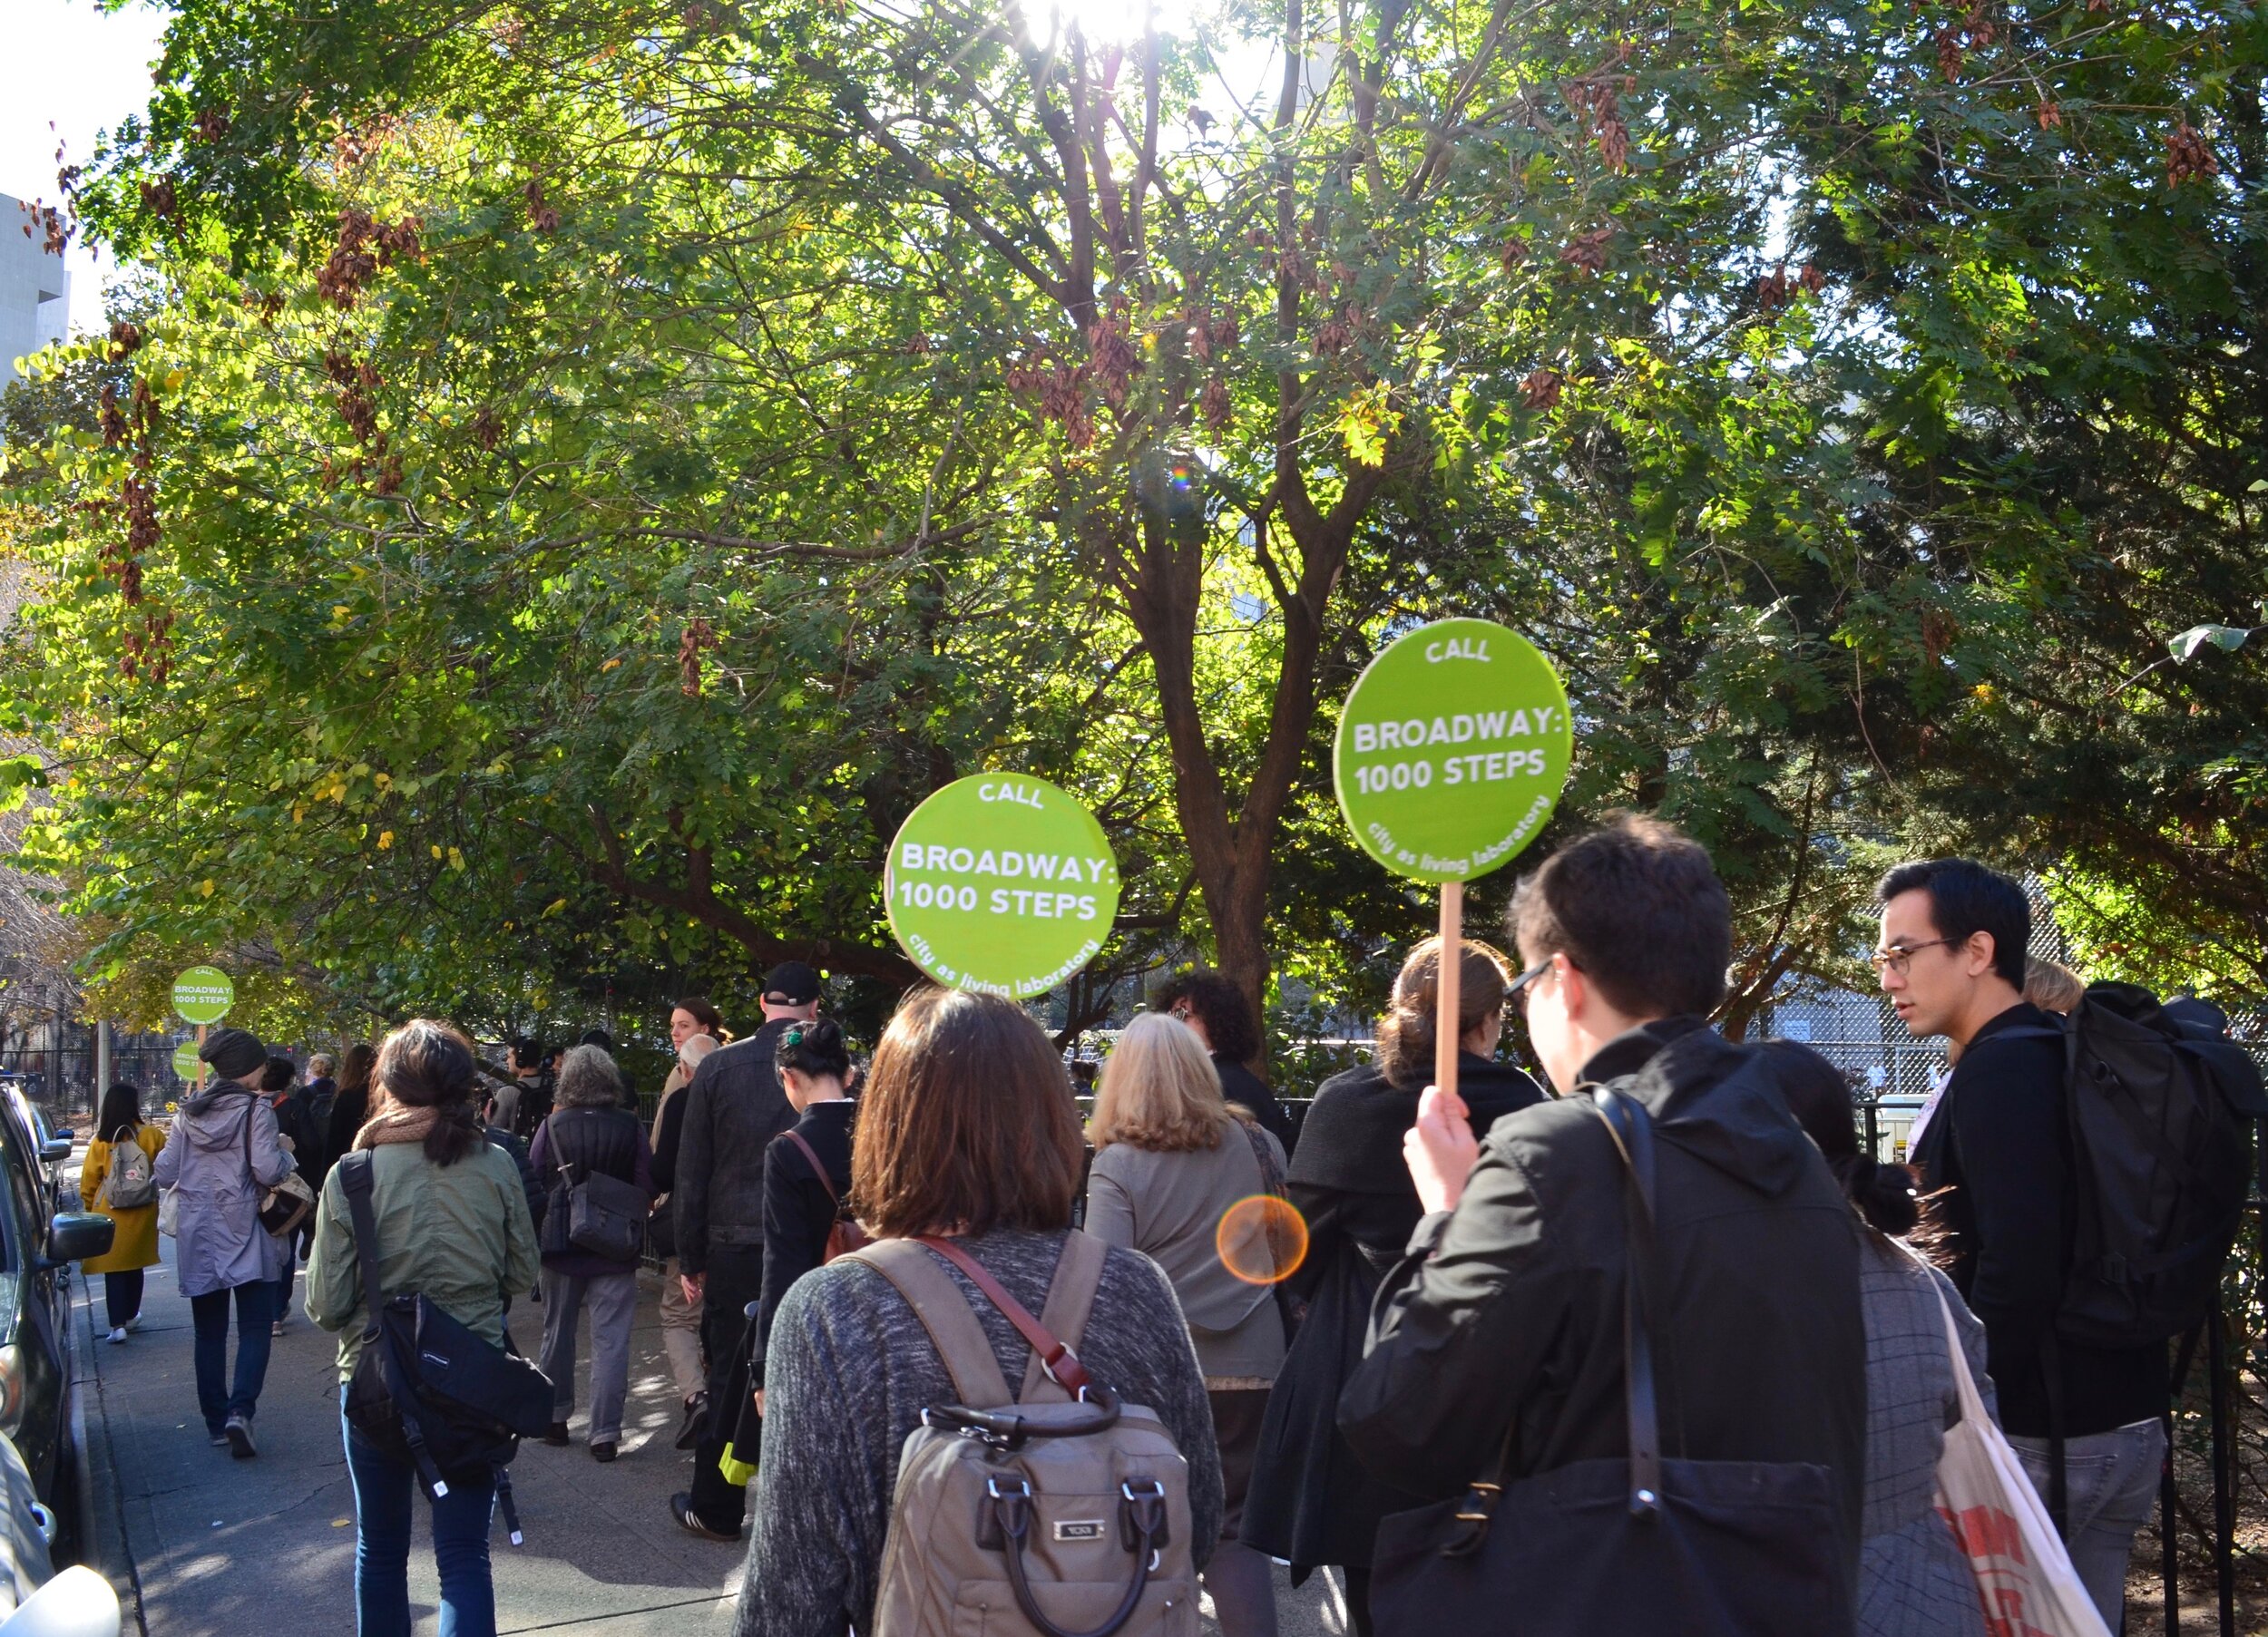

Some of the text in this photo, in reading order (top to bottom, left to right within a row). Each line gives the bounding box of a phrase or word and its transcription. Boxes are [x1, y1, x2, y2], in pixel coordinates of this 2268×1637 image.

[1425, 638, 1491, 663] CALL
[1354, 706, 1562, 753] BROADWAY:
[1354, 749, 1546, 794] 1000 STEPS
[978, 783, 1044, 809] CALL
[1368, 794, 1550, 875] city as living laboratory
[902, 843, 1115, 884] BROADWAY:
[900, 882, 1098, 921] 1000 STEPS
[909, 933, 1101, 997] city as living laboratory
[174, 986, 232, 994] BROADWAY:
